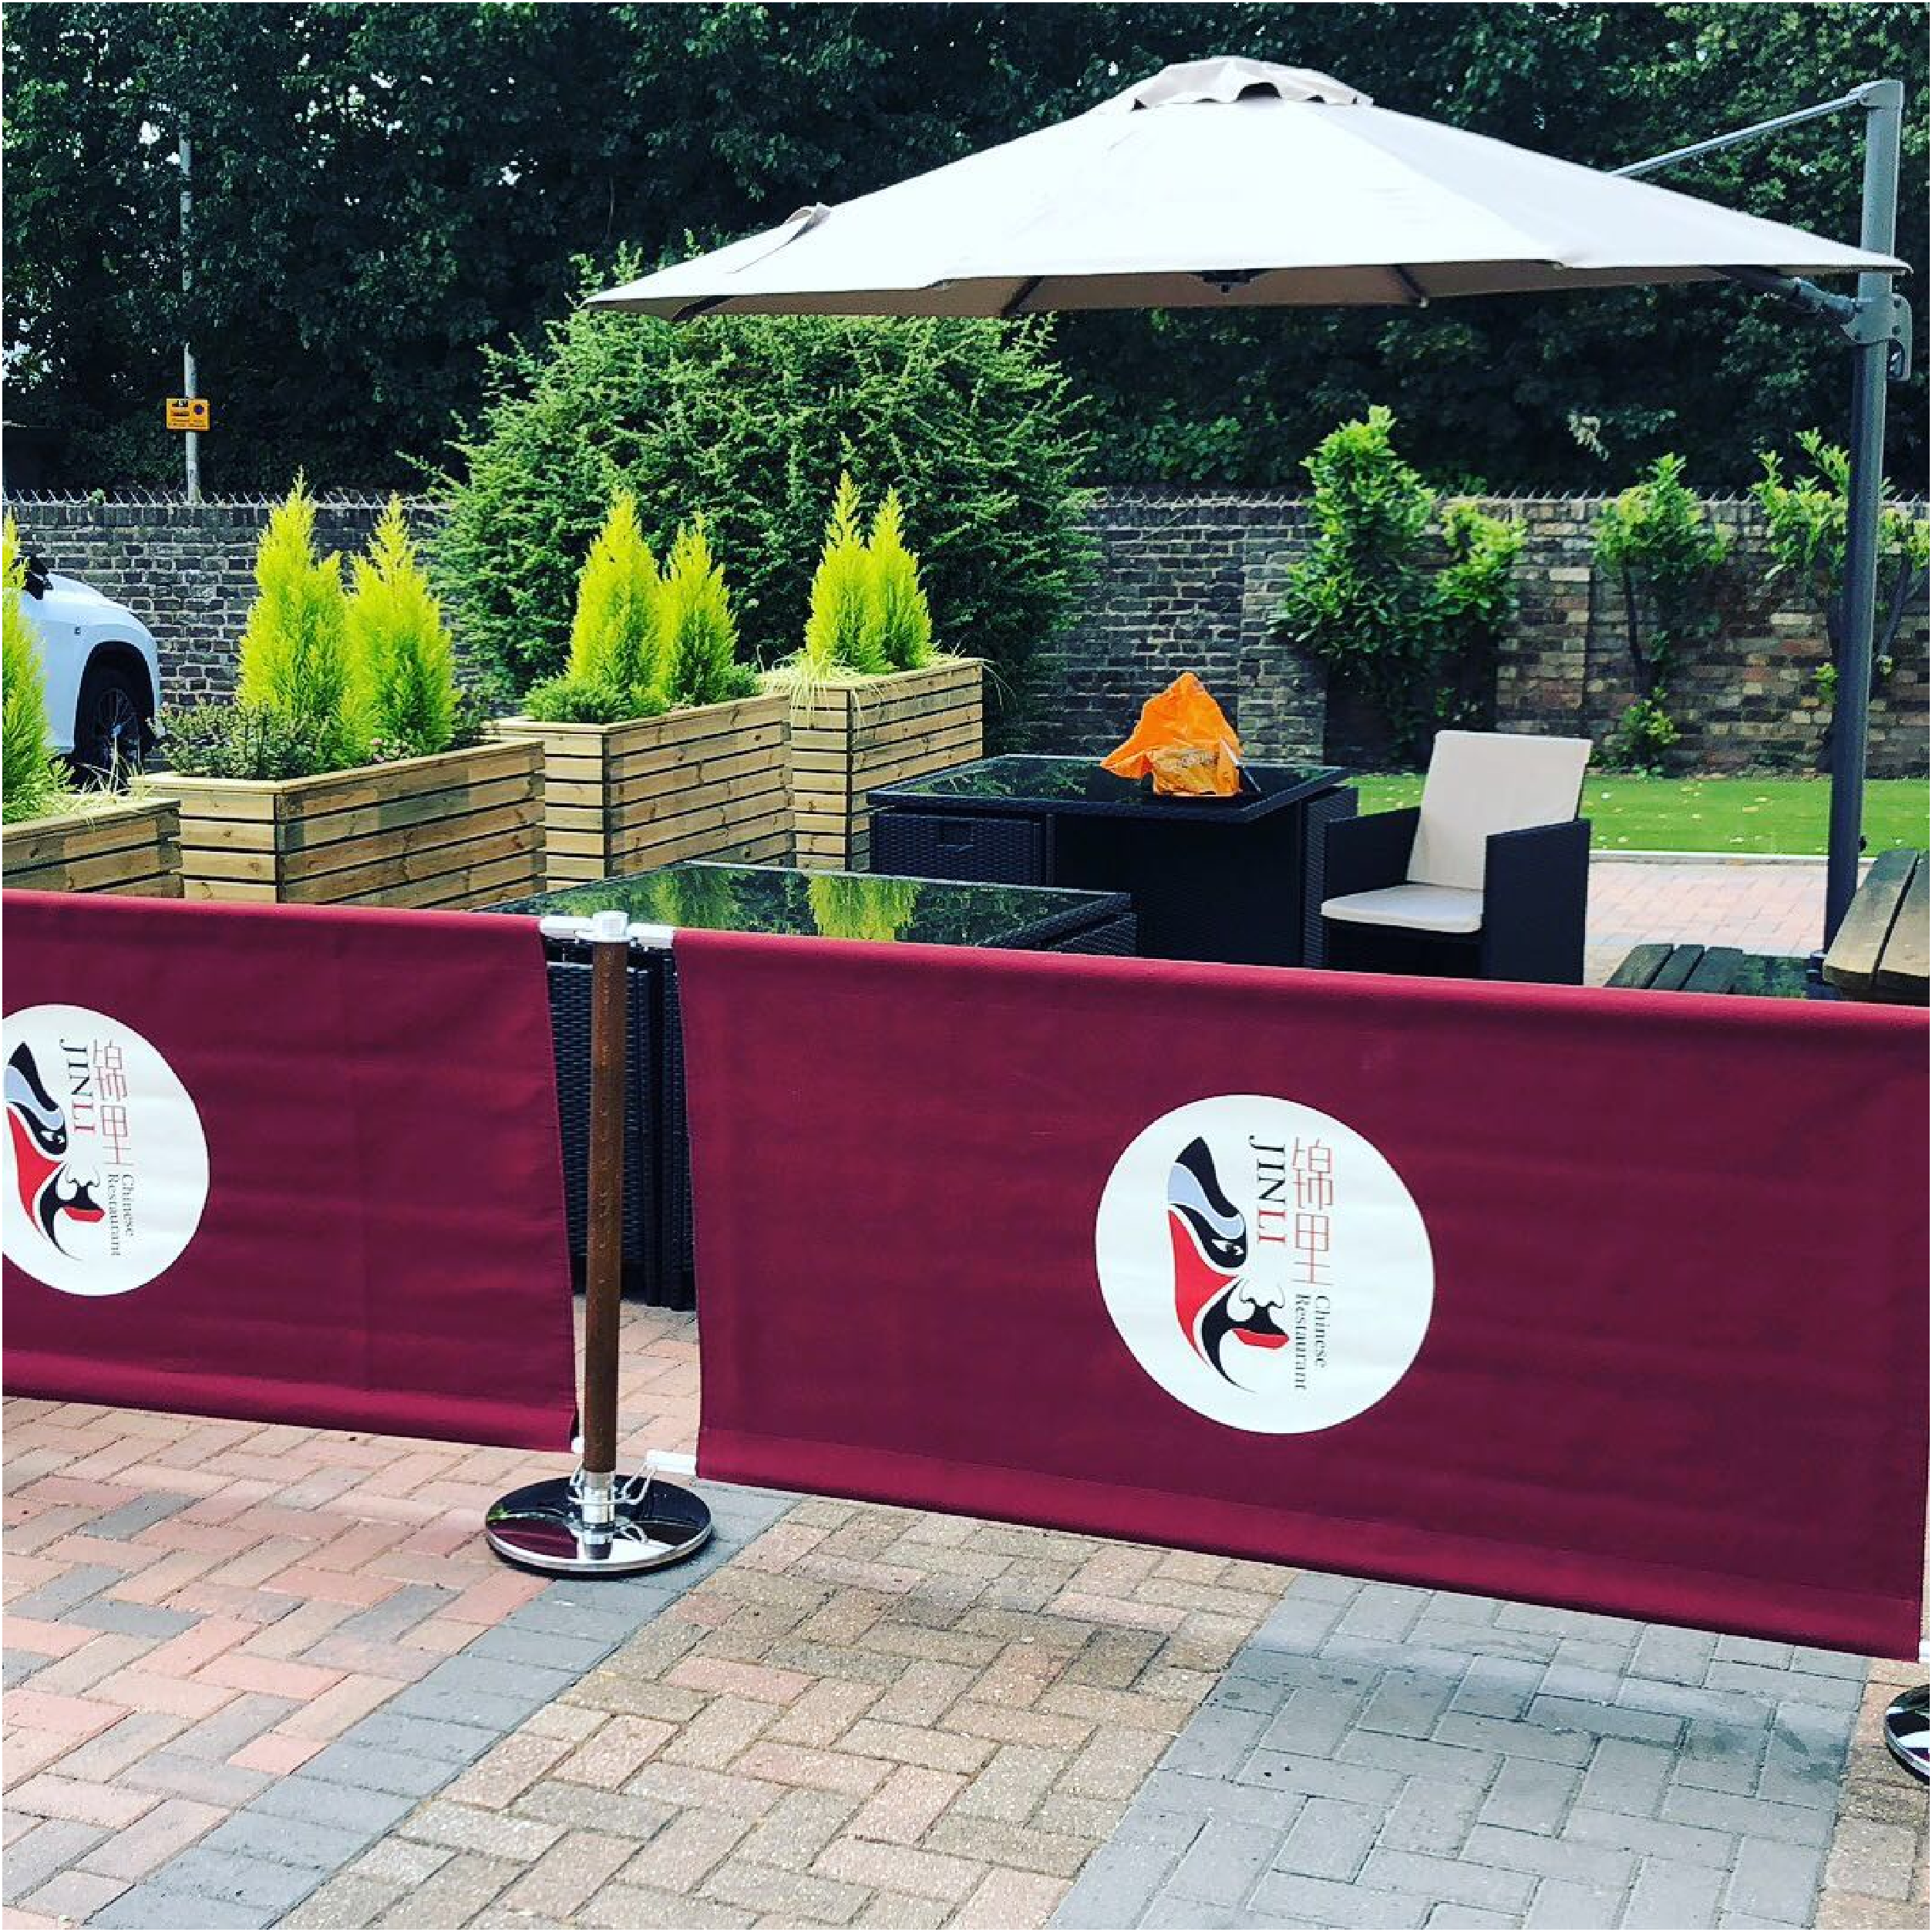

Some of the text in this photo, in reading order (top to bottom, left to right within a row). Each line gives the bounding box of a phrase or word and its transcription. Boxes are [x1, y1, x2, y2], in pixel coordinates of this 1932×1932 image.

[59, 1038, 96, 1134] JINLI
[93, 1039, 133, 1166] 锦里
[107, 1173, 122, 1256] Restaurant
[122, 1174, 134, 1237] Chinese
[1249, 1135, 1287, 1244] JINLI
[1291, 1136, 1335, 1286] 锦里
[1294, 1293, 1312, 1391] Restaurant
[1313, 1294, 1331, 1368] Chinese
